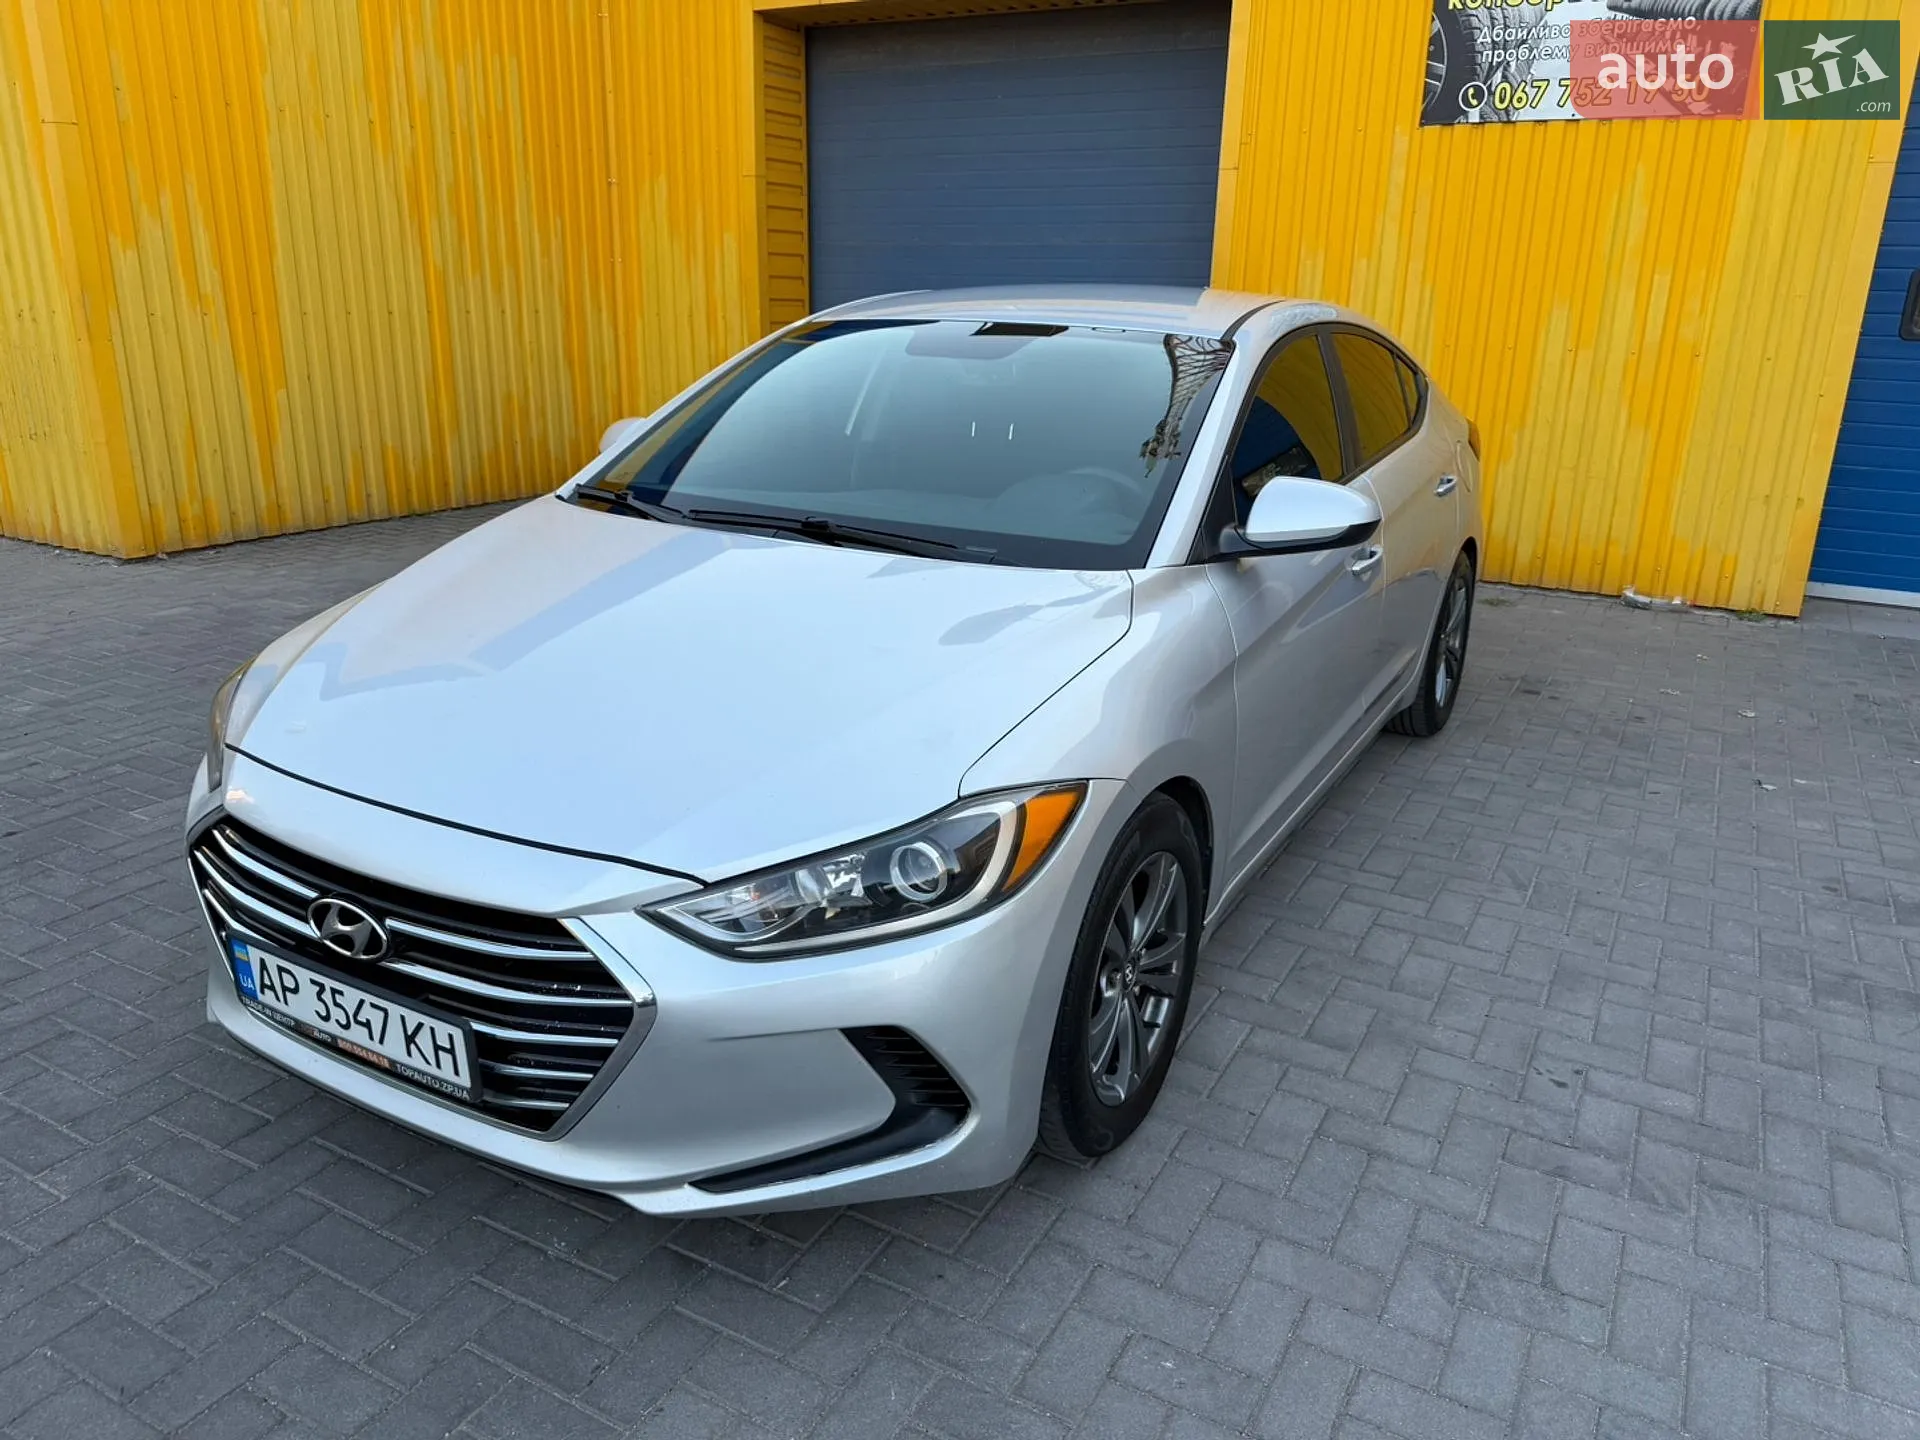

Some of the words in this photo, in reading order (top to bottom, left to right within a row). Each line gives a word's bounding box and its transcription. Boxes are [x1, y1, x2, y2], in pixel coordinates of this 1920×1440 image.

[1477, 22, 1572, 44] Дбайливо
[1481, 44, 1580, 66] проблему
[1494, 80, 1550, 110] 067
[1557, 77, 1612, 107] 752
[239, 973, 255, 991] UA
[259, 956, 301, 1007] AP
[309, 978, 390, 1046] 3547
[400, 1013, 461, 1077] KH
